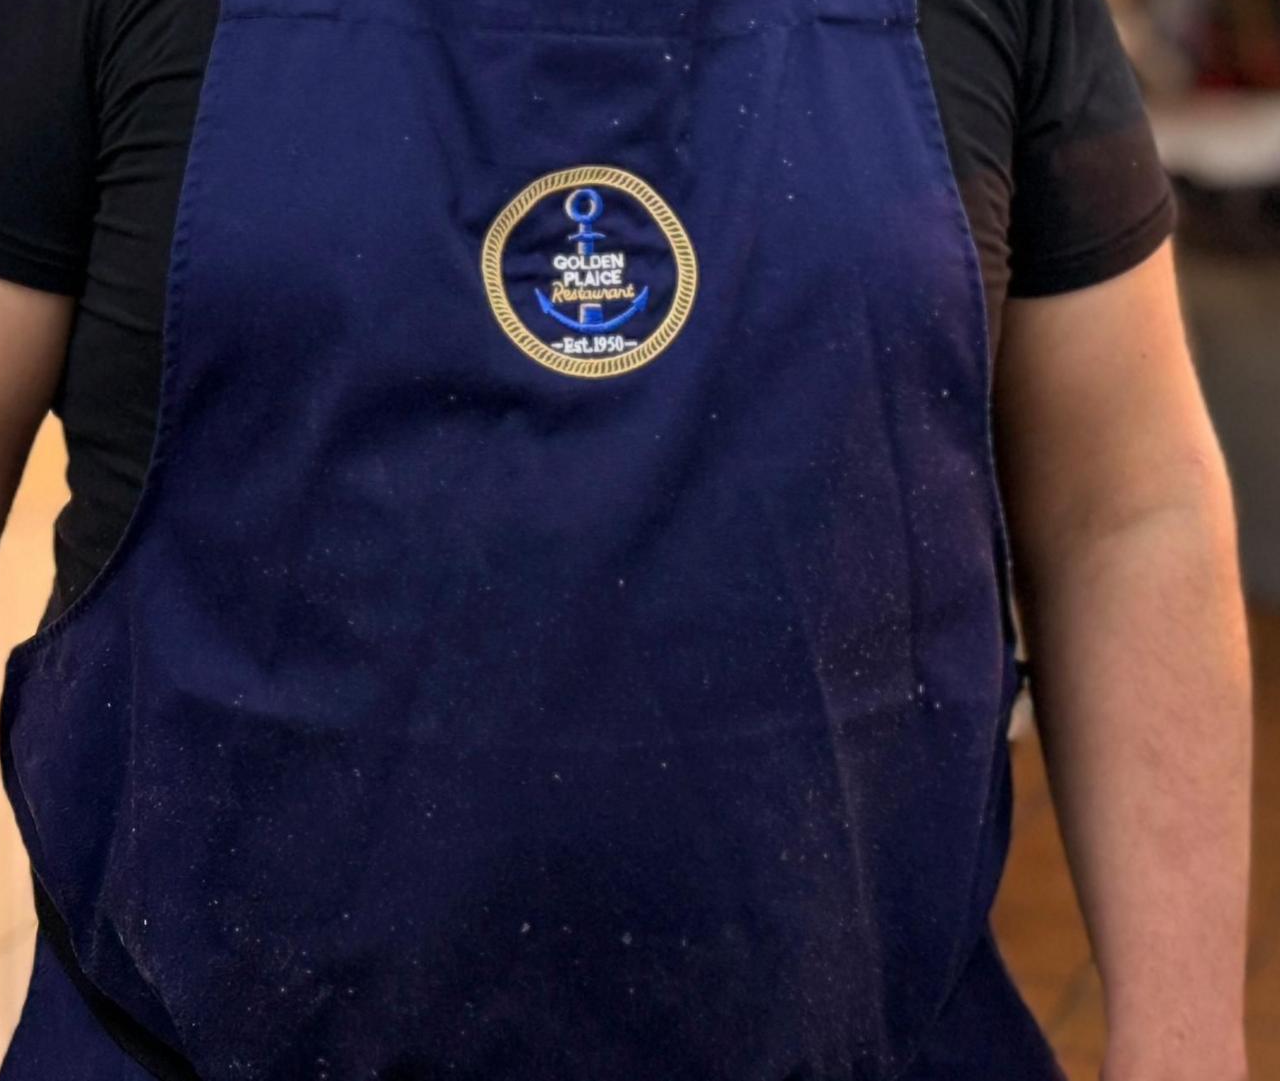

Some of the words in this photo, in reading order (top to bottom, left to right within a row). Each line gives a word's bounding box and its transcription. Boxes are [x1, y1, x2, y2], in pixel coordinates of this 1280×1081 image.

[553, 253, 624, 270] GOLDEN
[563, 269, 622, 287] PLAICE
[551, 281, 635, 303] Restaurant
